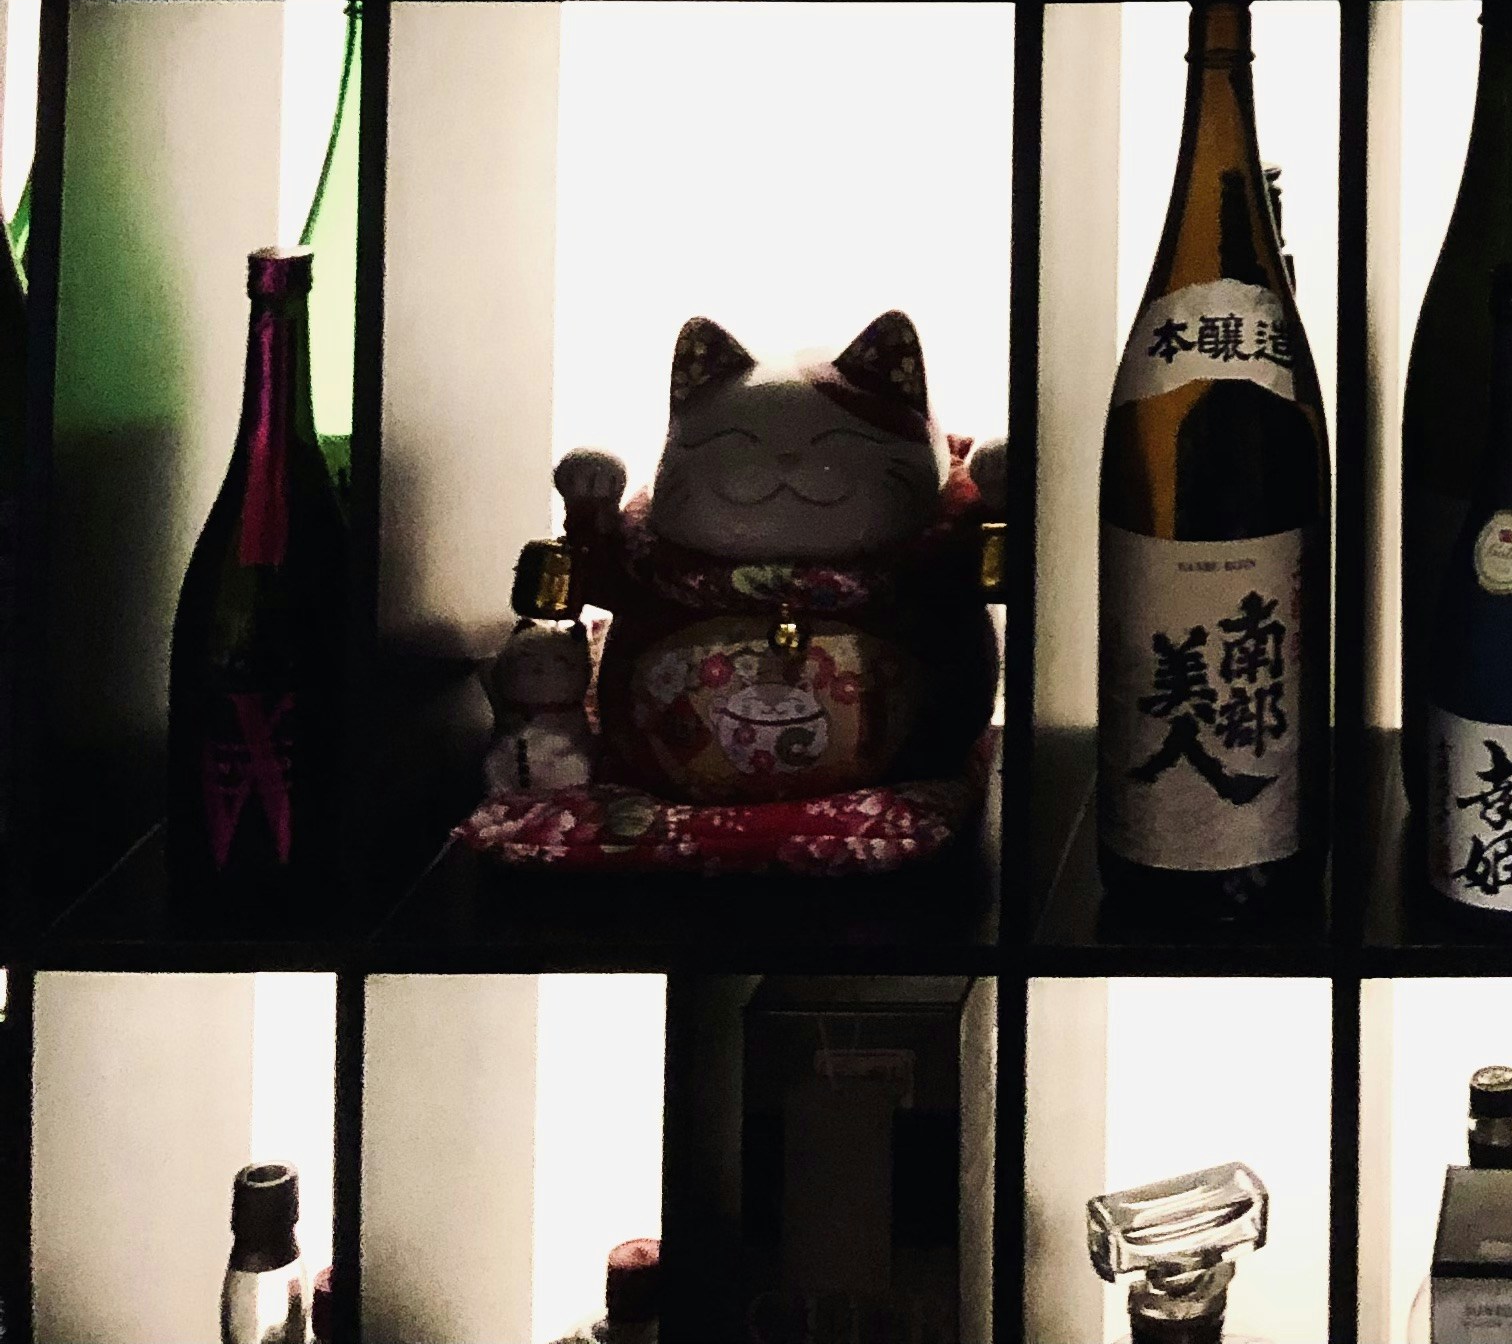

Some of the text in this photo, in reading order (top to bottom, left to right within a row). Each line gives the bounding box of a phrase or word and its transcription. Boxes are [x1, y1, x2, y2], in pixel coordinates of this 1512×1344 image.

[1150, 313, 1295, 368] 本醸造
[1128, 626, 1280, 807] 美人
[1219, 591, 1288, 758] 南部
